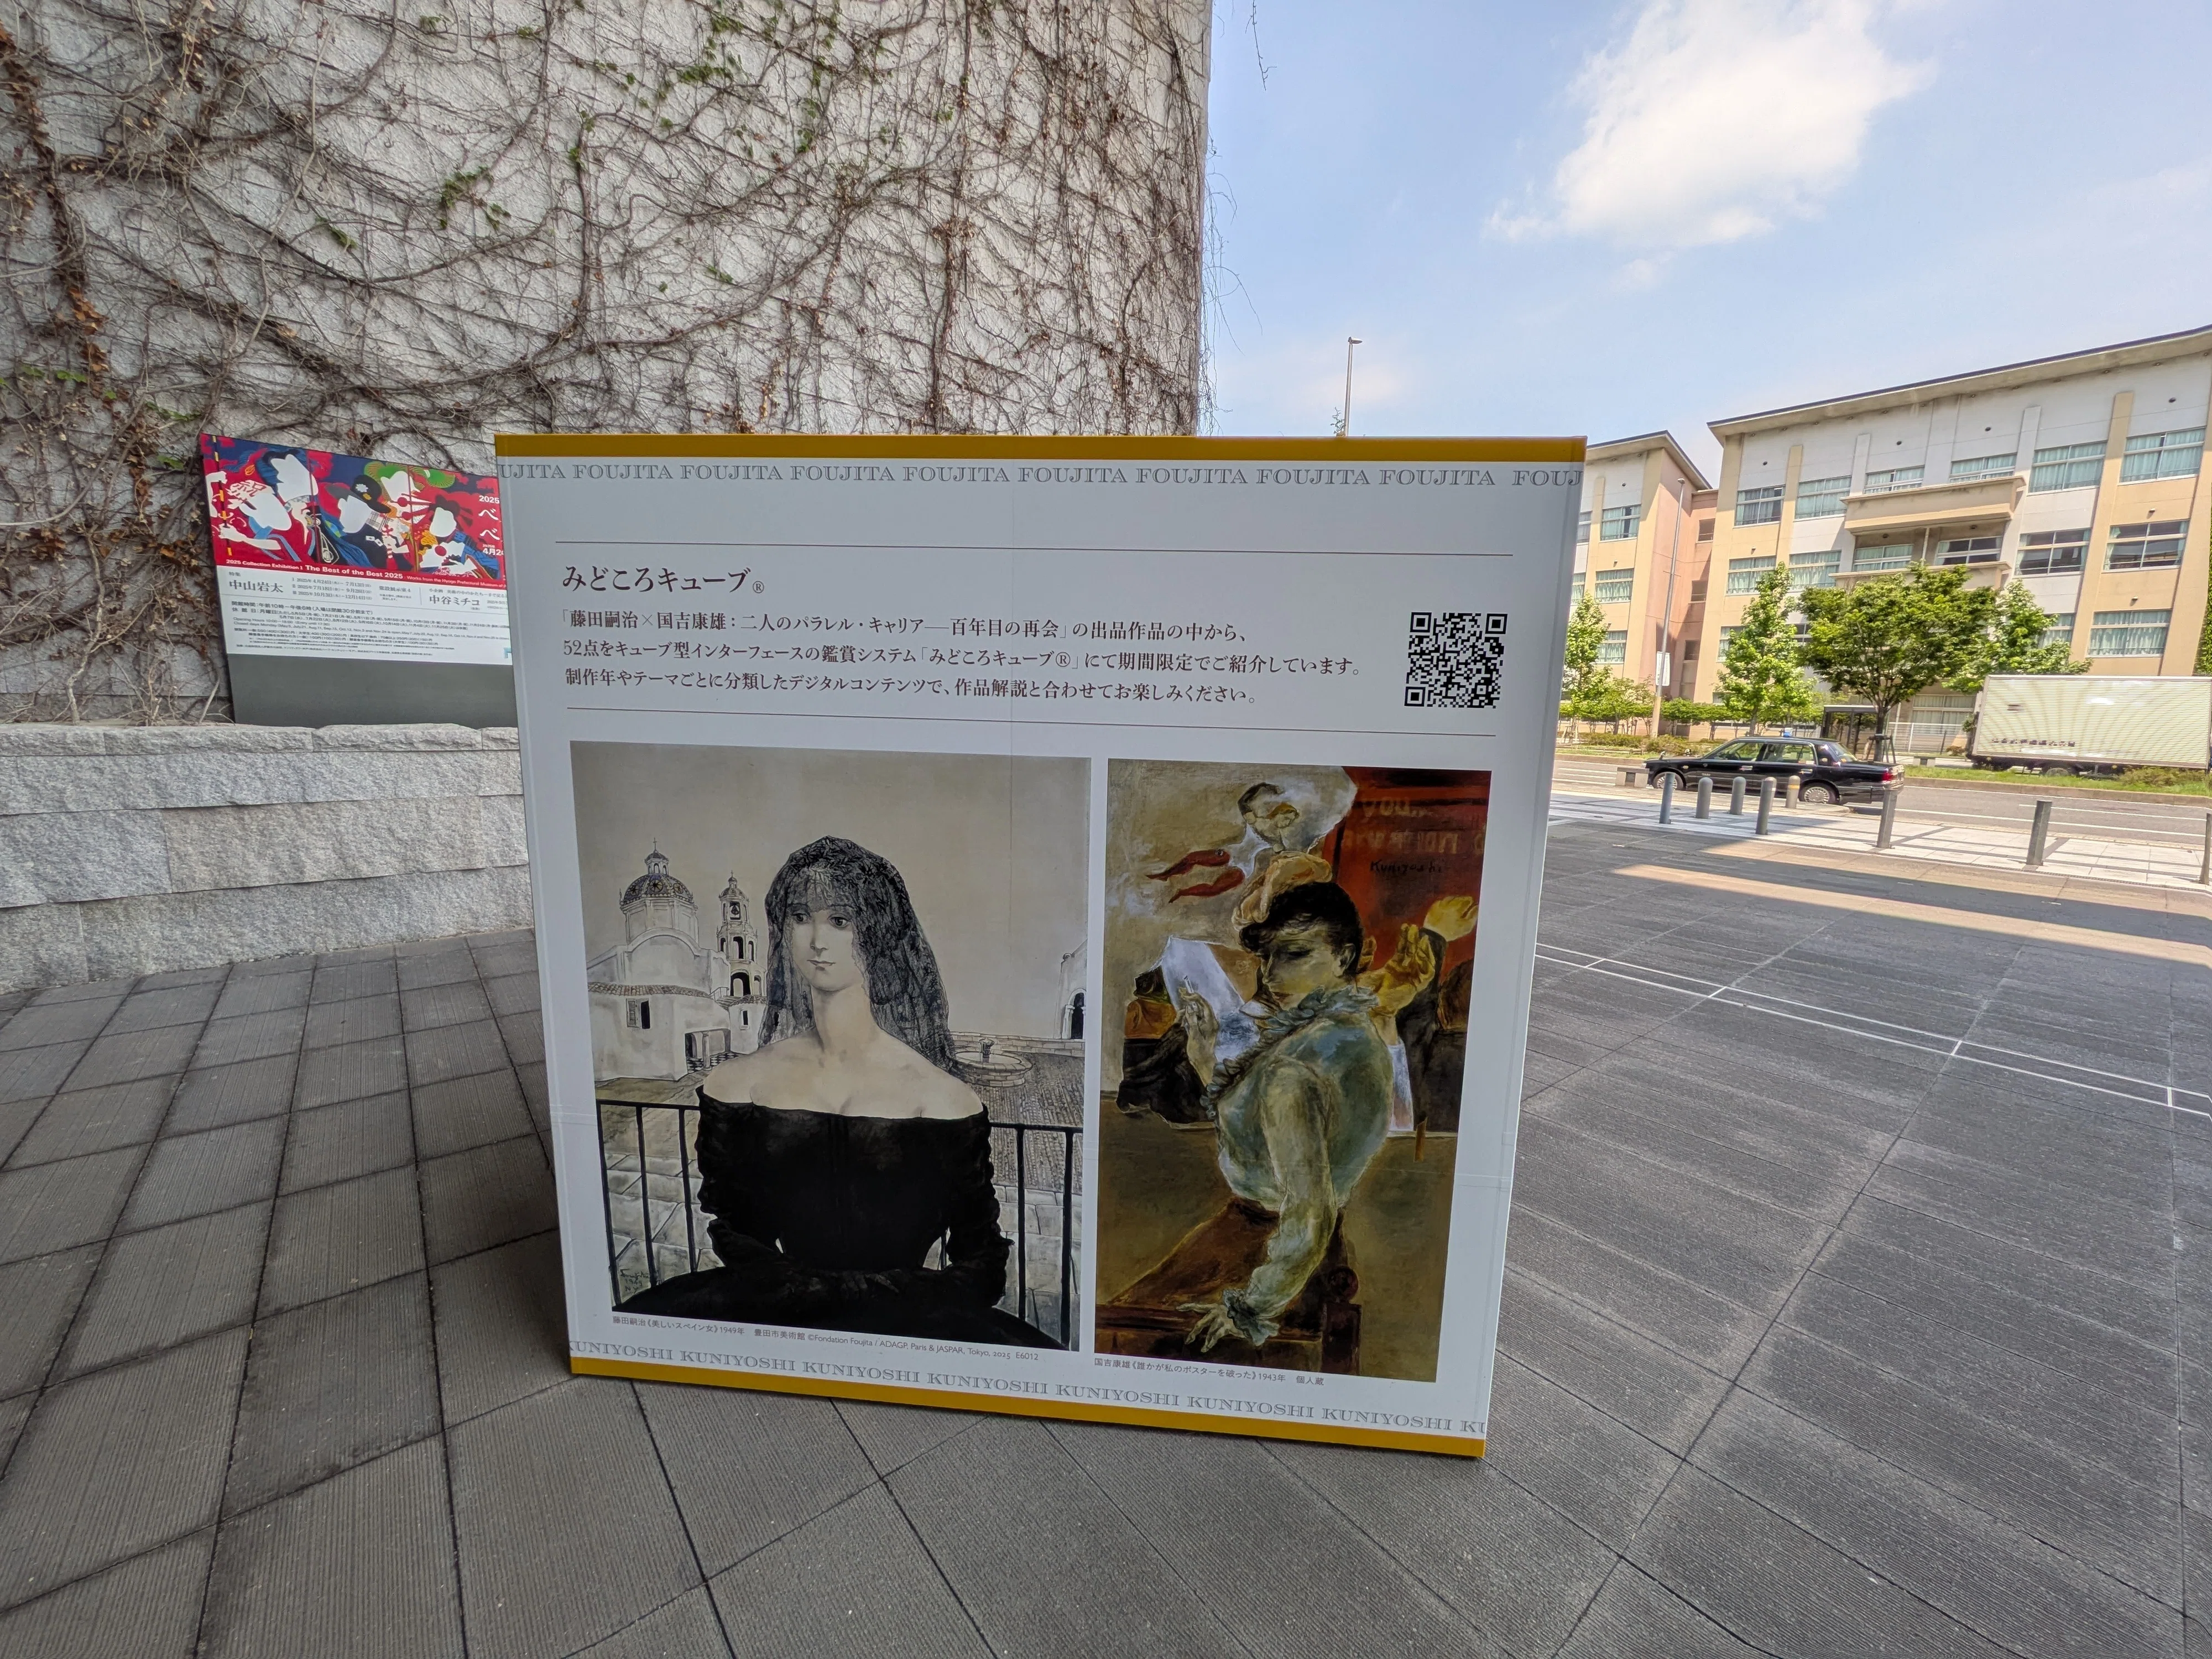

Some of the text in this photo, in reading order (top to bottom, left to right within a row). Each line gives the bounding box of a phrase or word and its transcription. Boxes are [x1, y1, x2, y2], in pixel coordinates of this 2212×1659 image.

[572, 465, 674, 479] FOUJITA
[680, 465, 783, 479] FOUJITA
[790, 466, 895, 481] FOUJITA
[902, 467, 1010, 482] FOUJITA
[1018, 467, 1128, 483] FOUJITA
[1135, 468, 1248, 483] FOUJITA
[1256, 469, 1370, 484] FOUJITA
[1379, 469, 1495, 485] FOUJITA
[479, 495, 500, 504] 2025
[229, 580, 283, 592] 中山岩太
[429, 595, 479, 606] 中谷ミチコ
[754, 1328, 805, 1340] 豊田市美術館
[851, 1338, 873, 1347] Foujita
[936, 1345, 965, 1355] JASPAR,
[968, 1348, 990, 1357] Tokyo,
[1016, 1352, 1039, 1360] E6012
[1296, 1375, 1324, 1385] 個人蔵
[680, 1350, 796, 1371] KUNIYOSHI
[803, 1361, 920, 1383] KUNIYOSHI
[927, 1373, 1048, 1394] KUNIYOSHI
[1055, 1384, 1180, 1406] KUNIYOSHI
[1187, 1396, 1314, 1417] KUNIYOSHI
[1322, 1408, 1453, 1431] KUNIYOSHI
